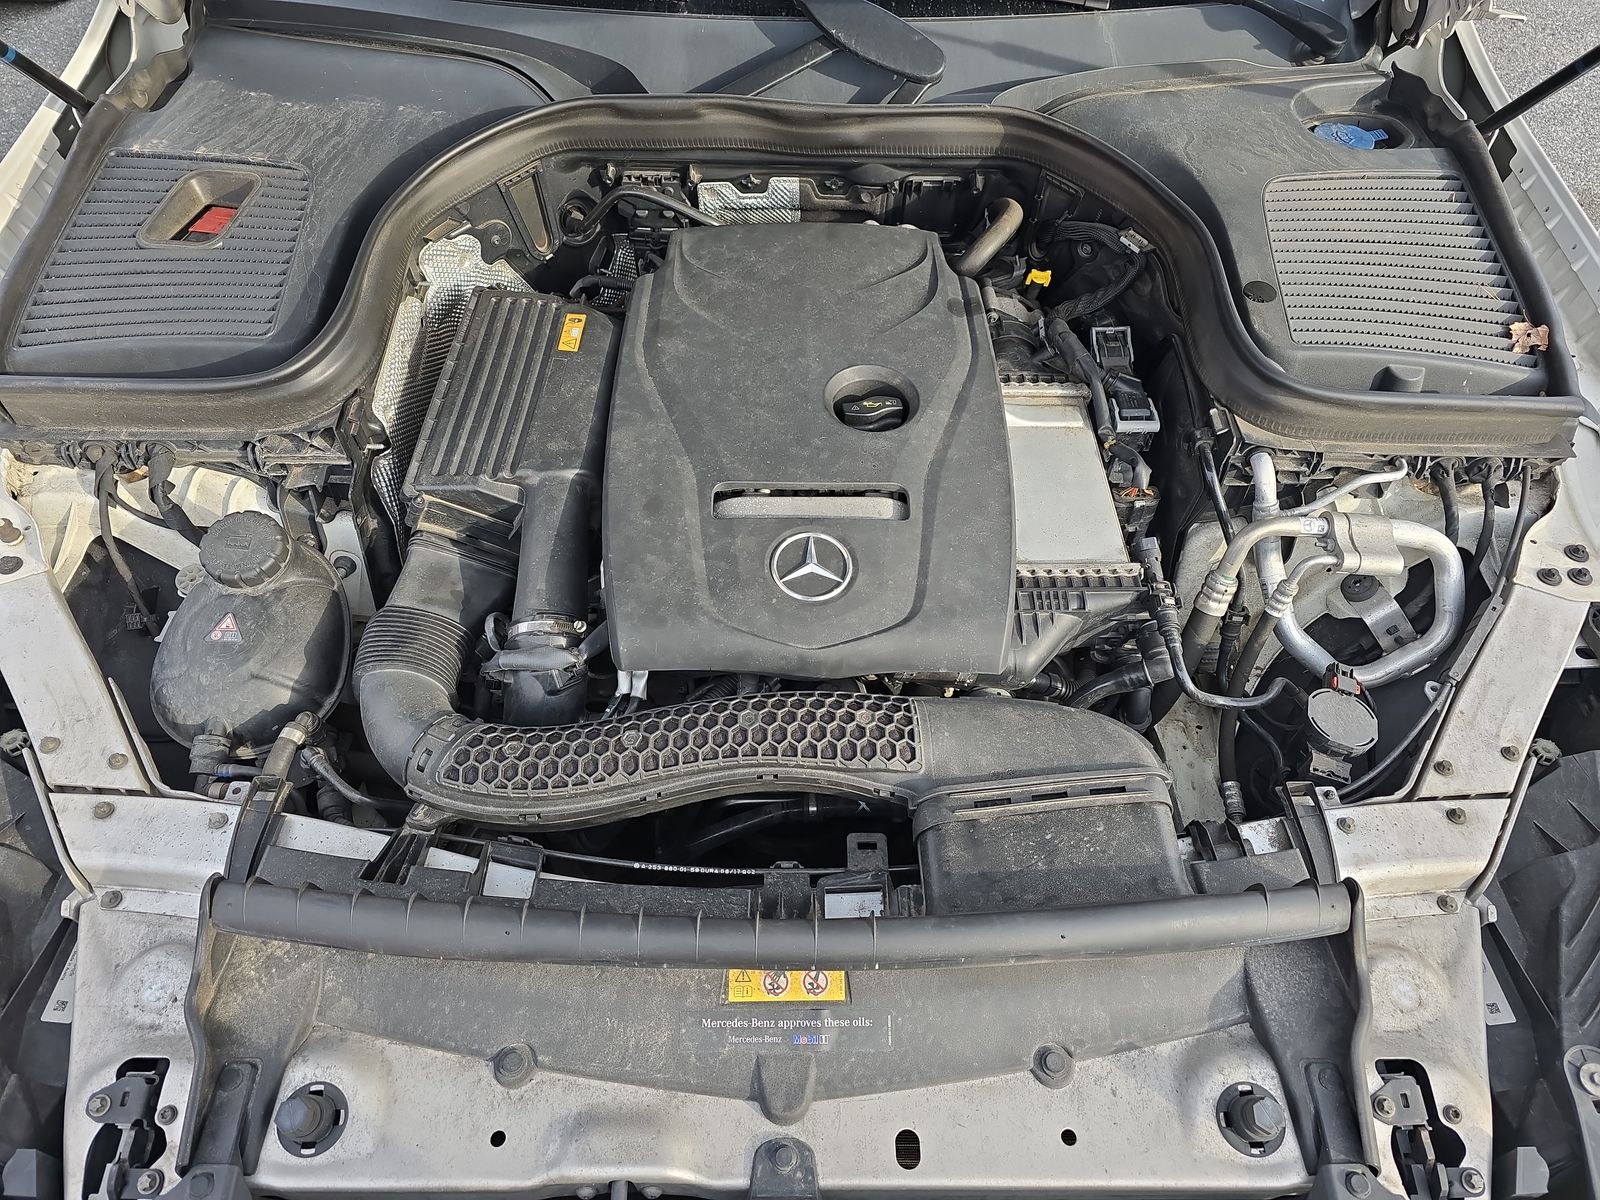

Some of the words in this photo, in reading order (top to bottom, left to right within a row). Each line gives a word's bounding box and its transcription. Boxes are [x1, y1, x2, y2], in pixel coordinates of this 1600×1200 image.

[701, 1018, 776, 1028] Mercedes-Benz
[777, 1019, 822, 1030] approves
[824, 1017, 851, 1027] these
[852, 1016, 873, 1027] oils:
[728, 1034, 783, 1043] Mercedes-Benz
